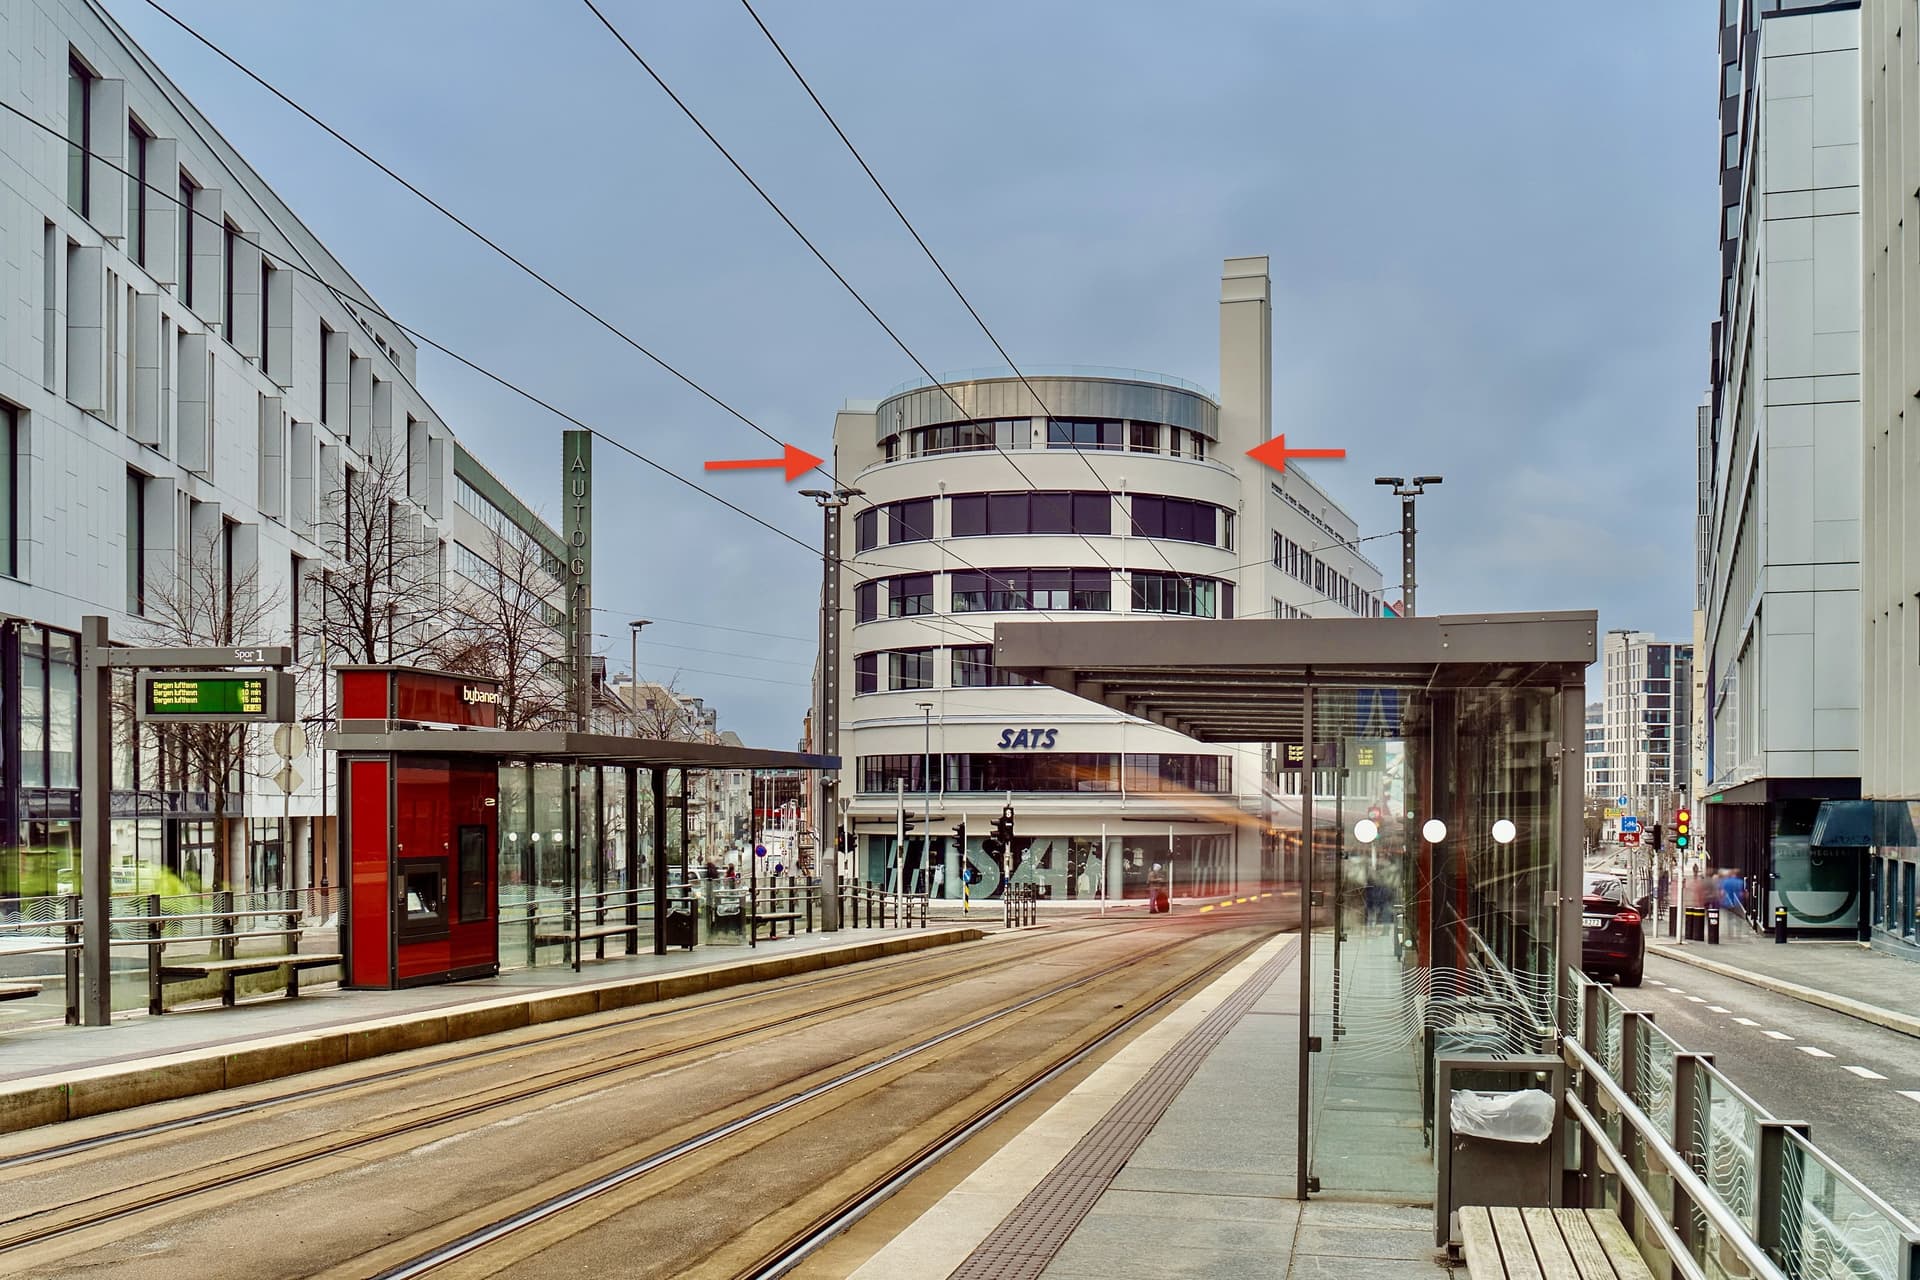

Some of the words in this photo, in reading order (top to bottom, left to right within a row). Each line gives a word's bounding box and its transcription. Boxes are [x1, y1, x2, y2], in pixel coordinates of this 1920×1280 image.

[234, 649, 255, 660] Spor
[255, 650, 265, 662] 1
[153, 682, 174, 690] Bergen
[153, 689, 174, 697] Bergen
[250, 688, 261, 696] min
[463, 685, 500, 705] bybanen
[153, 697, 174, 705] Bergen
[997, 728, 1059, 749] SATS
